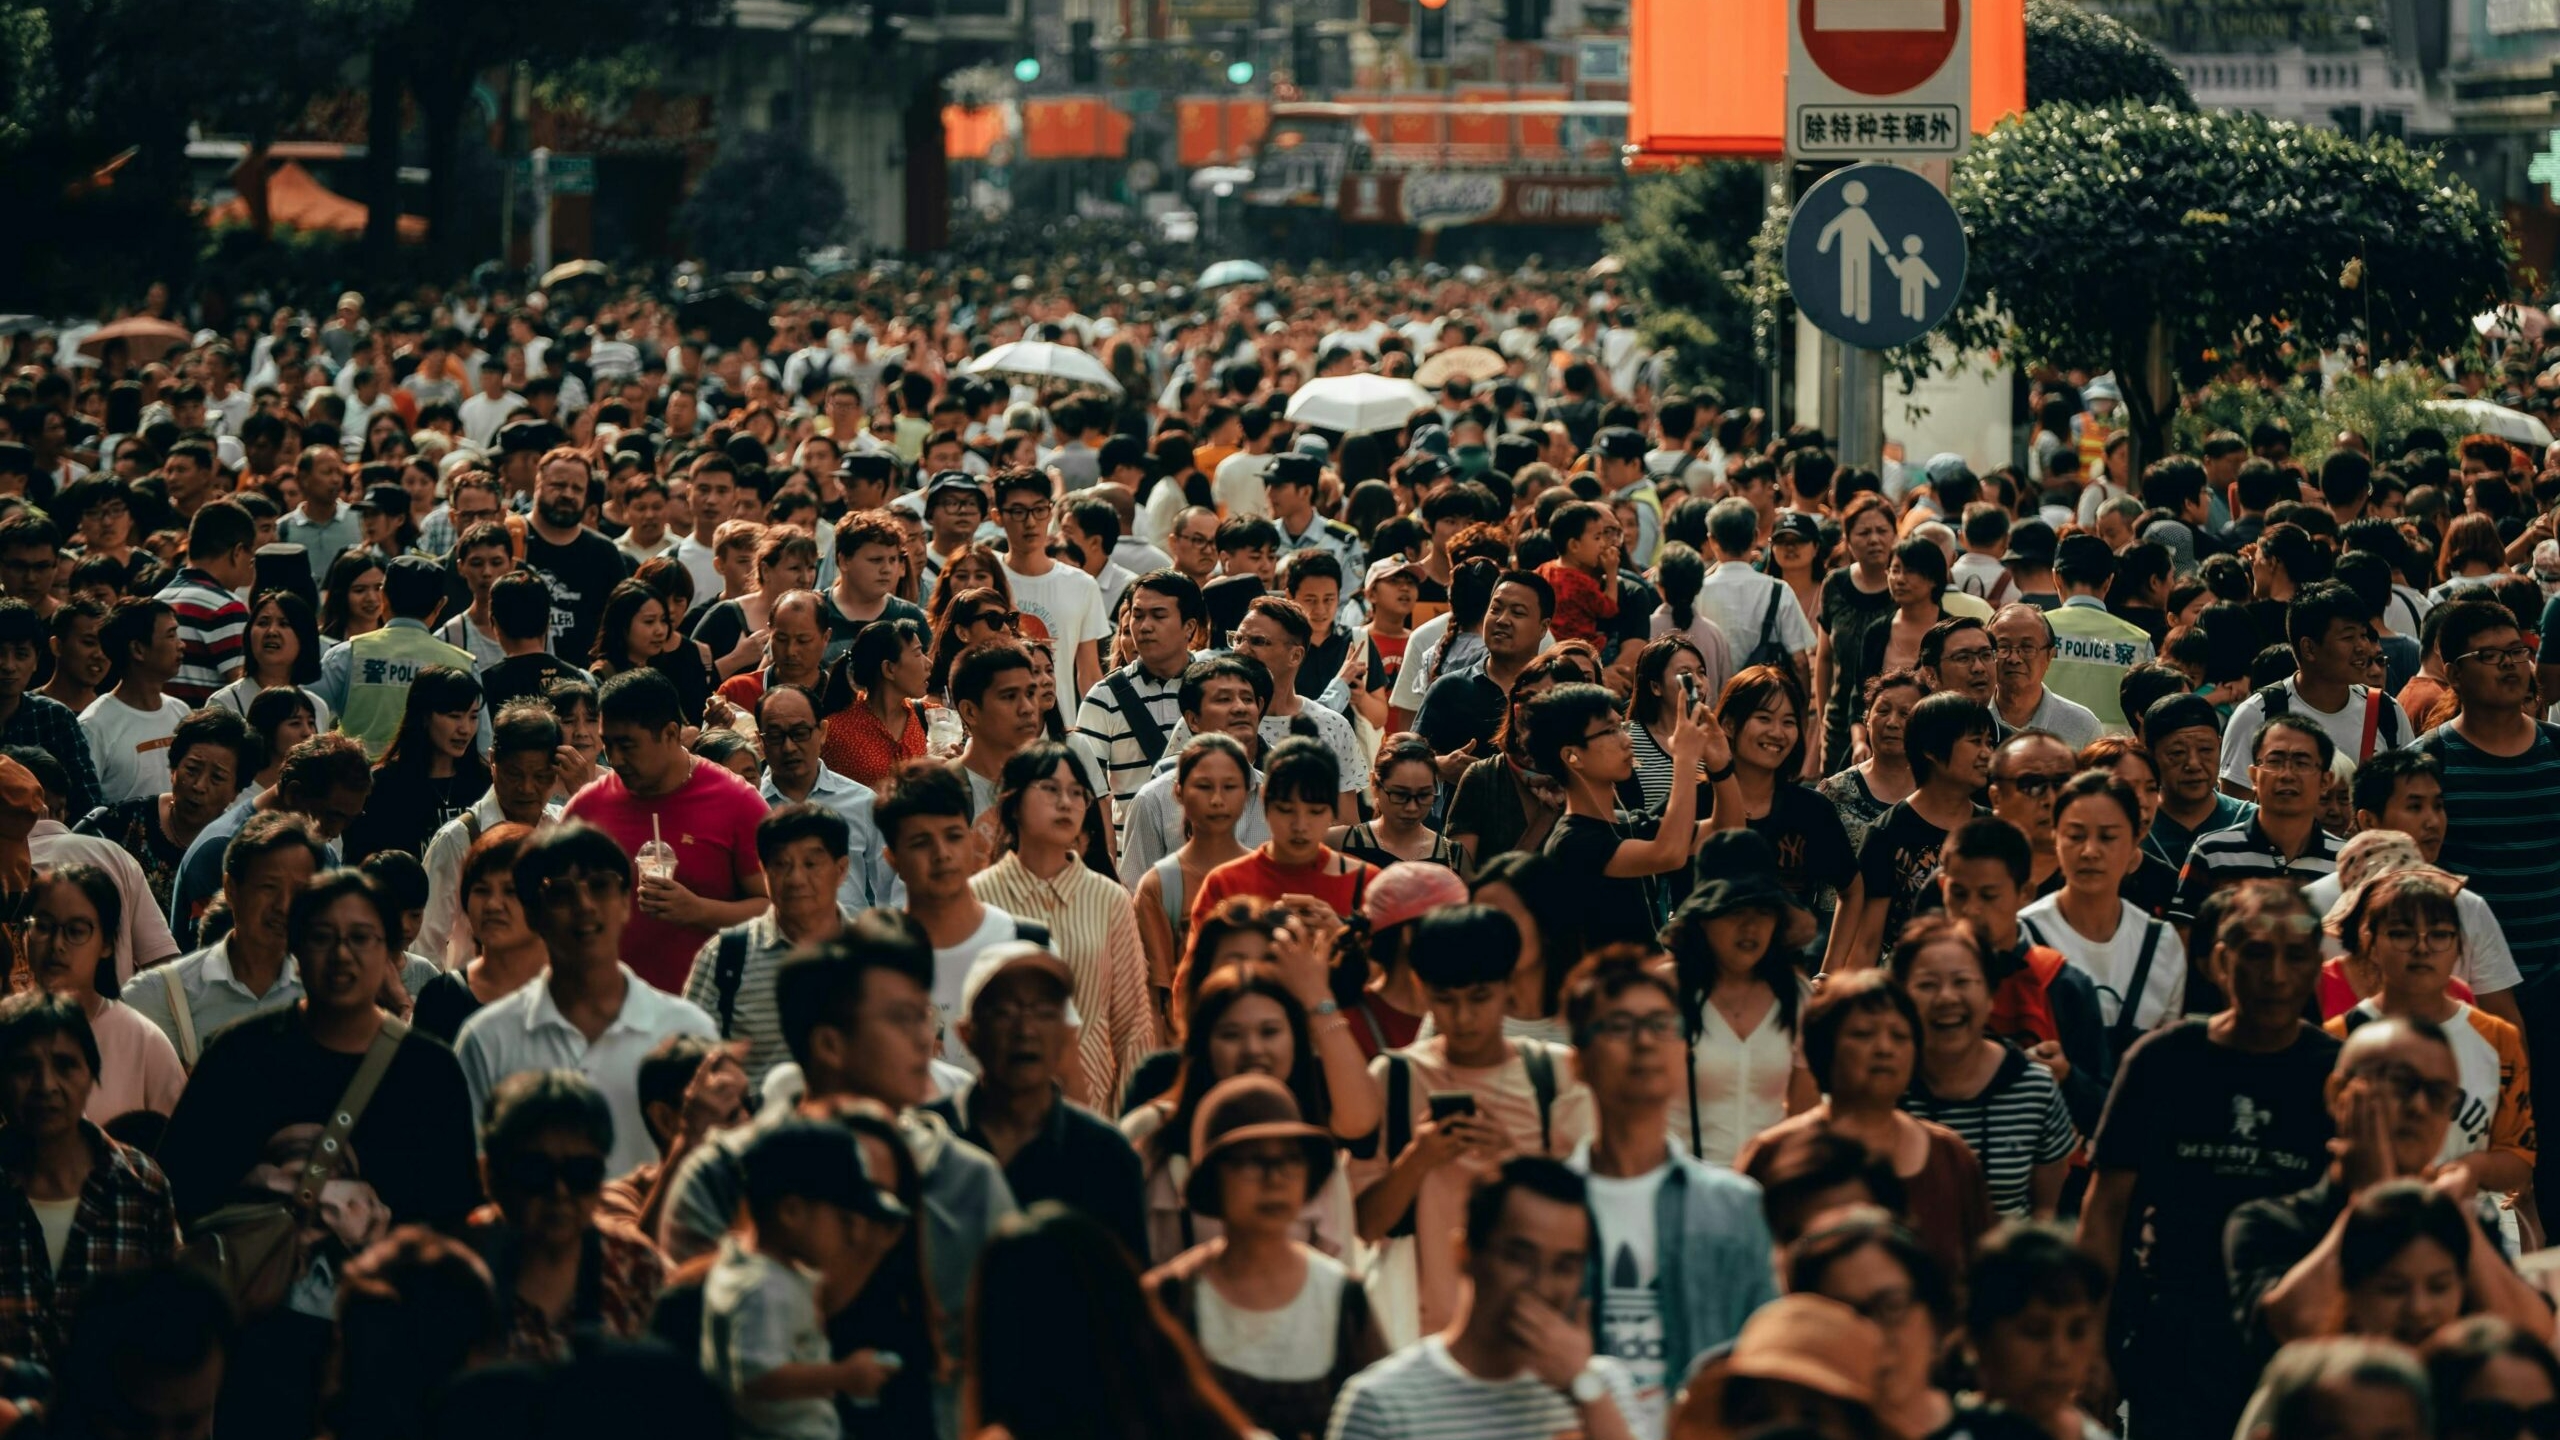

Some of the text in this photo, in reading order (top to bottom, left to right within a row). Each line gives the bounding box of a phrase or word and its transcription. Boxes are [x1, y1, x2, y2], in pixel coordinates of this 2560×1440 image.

[1804, 112, 1951, 144] 除特种车辆外
[2065, 640, 2110, 659] POLICE
[2115, 643, 2136, 665] 察
[363, 659, 387, 684] 警
